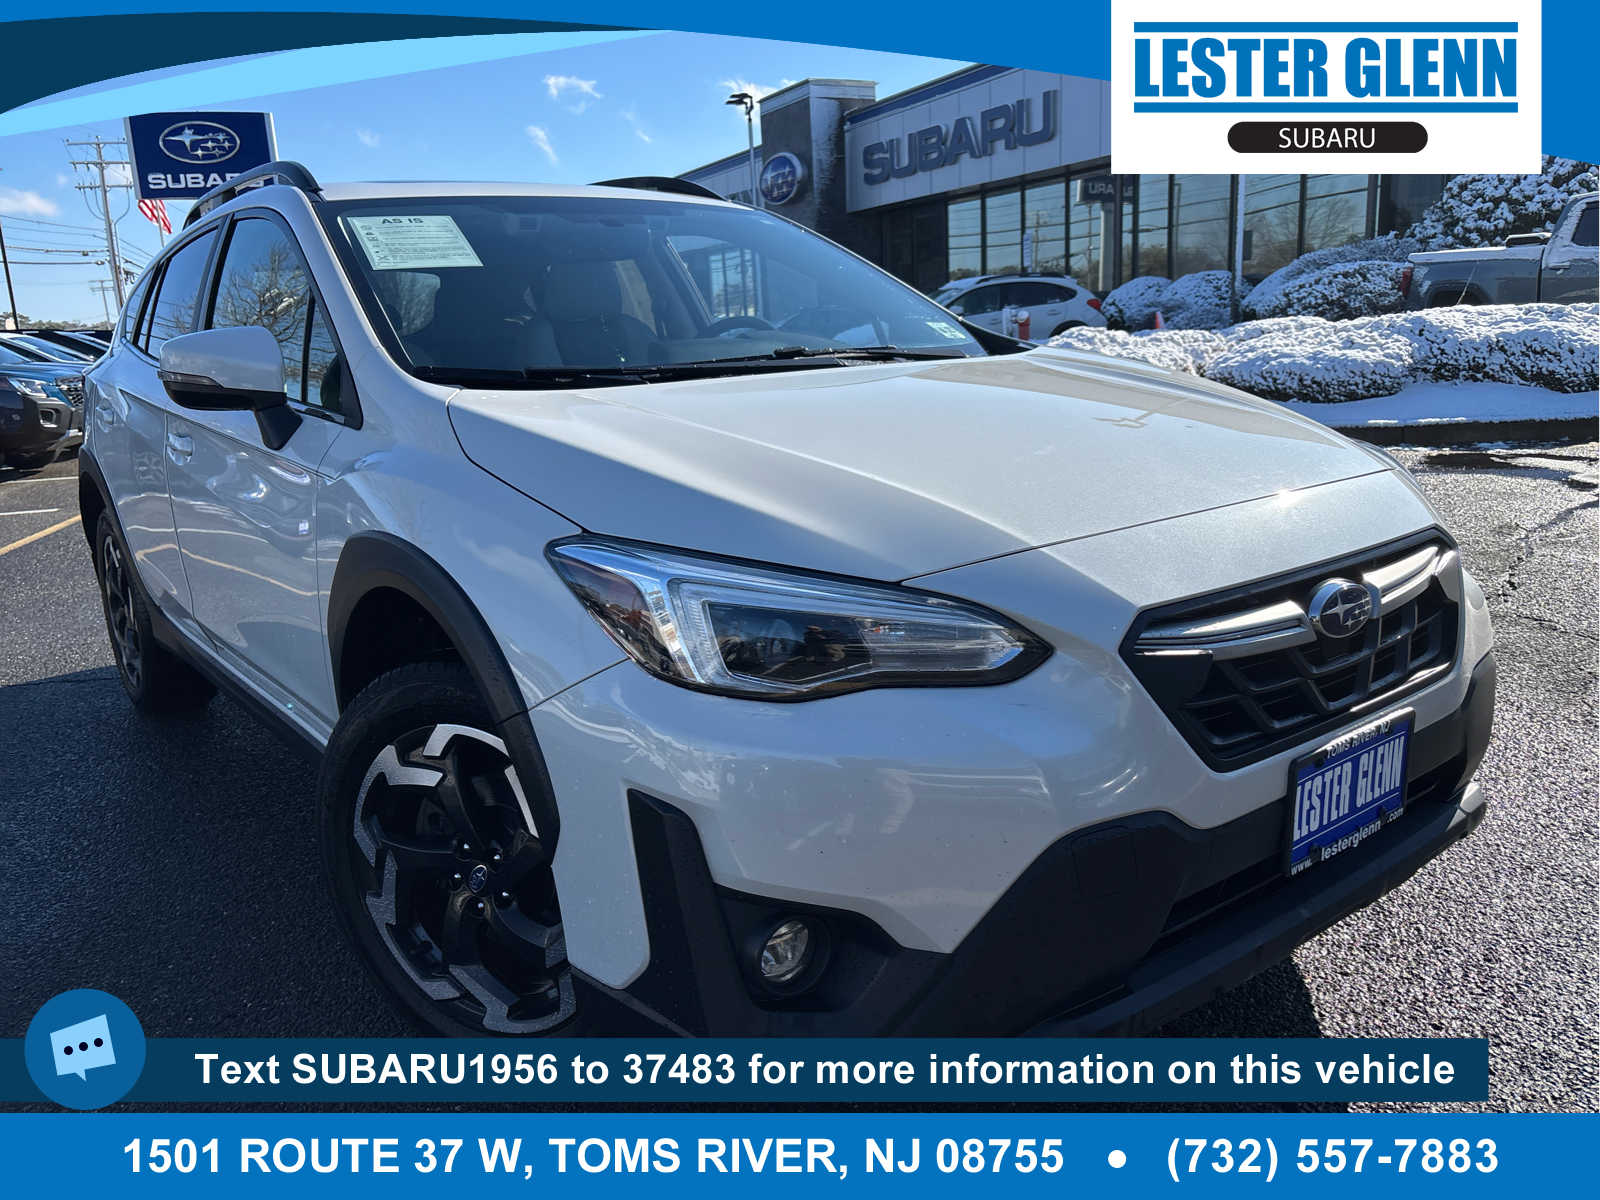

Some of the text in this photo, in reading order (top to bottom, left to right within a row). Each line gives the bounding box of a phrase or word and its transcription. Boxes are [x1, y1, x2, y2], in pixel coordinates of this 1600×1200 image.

[863, 90, 1058, 186] SUBARU
[148, 173, 264, 190] SUBA
[1326, 739, 1350, 759] TOMS
[1293, 735, 1405, 842] LESTER GLENN
[1321, 820, 1381, 861] lesterglenn
